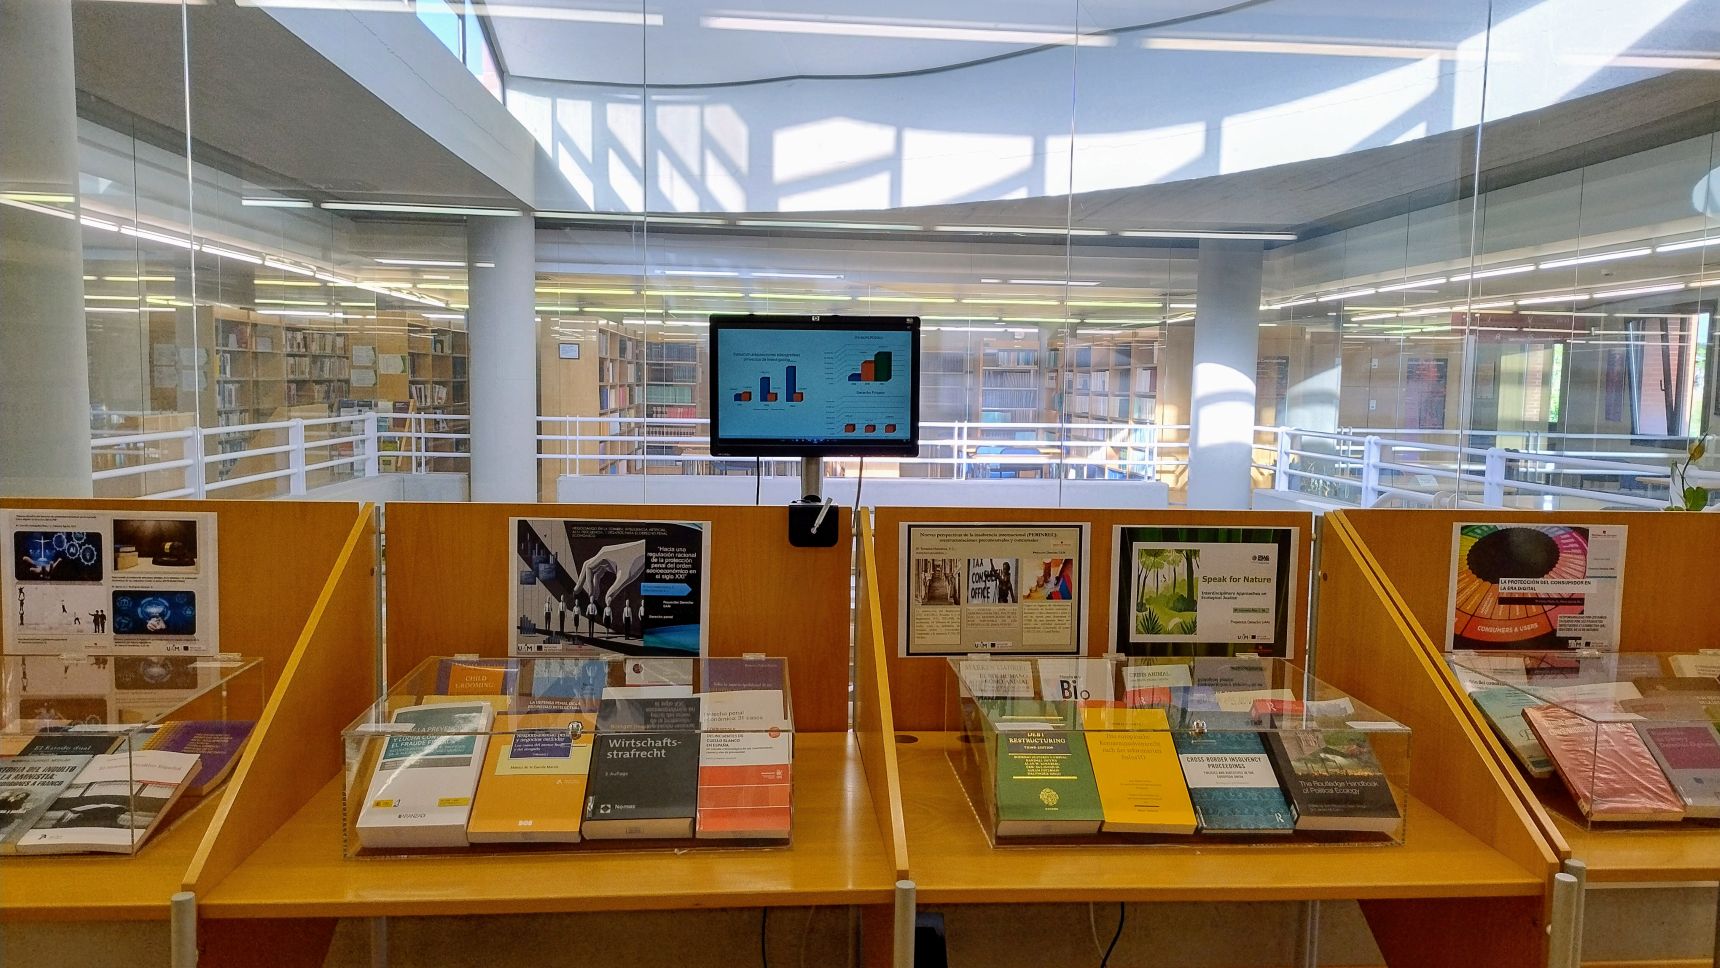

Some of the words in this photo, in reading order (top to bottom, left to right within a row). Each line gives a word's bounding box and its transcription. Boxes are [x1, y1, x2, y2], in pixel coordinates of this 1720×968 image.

[1202, 576, 1227, 584] Speak
[1520, 623, 1538, 631] USERS
[608, 738, 682, 747] Wirtschafts-
[607, 749, 666, 758] strafrecht
